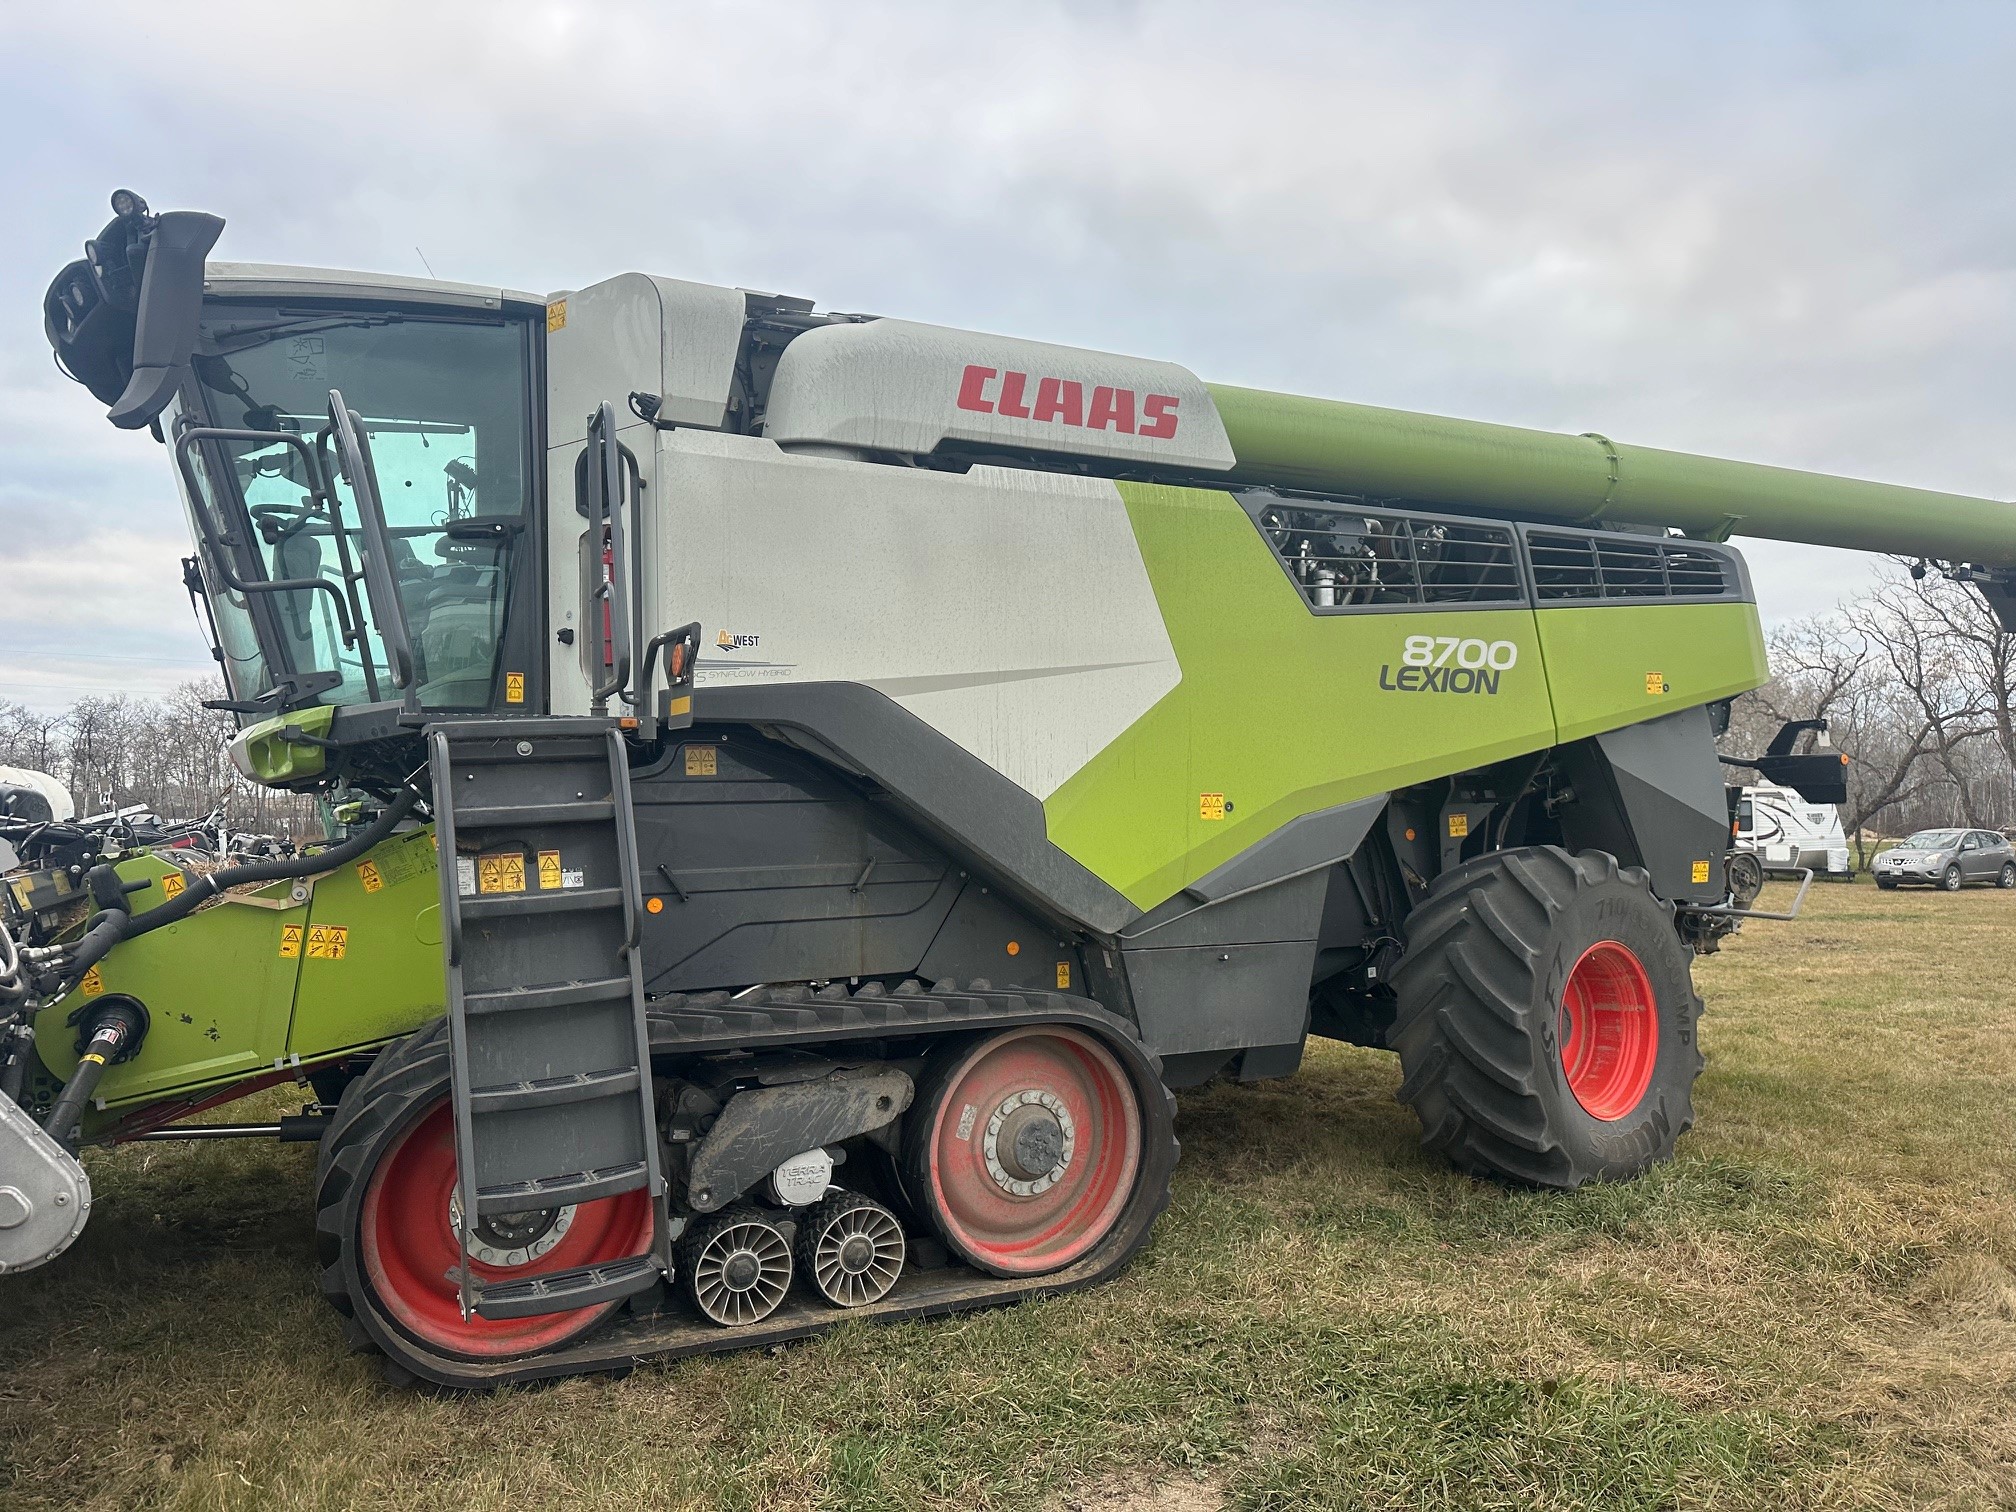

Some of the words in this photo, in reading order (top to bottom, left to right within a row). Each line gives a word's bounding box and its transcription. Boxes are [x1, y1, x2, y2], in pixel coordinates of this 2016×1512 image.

[956, 364, 1180, 439] CLAAS
[1402, 635, 1518, 671] 8700
[708, 669, 756, 679] SYNFLOW
[757, 668, 792, 677] HYBRID
[1379, 664, 1500, 695] LEXION
[782, 1165, 825, 1177] TERRA
[786, 1175, 823, 1187] TRAC
